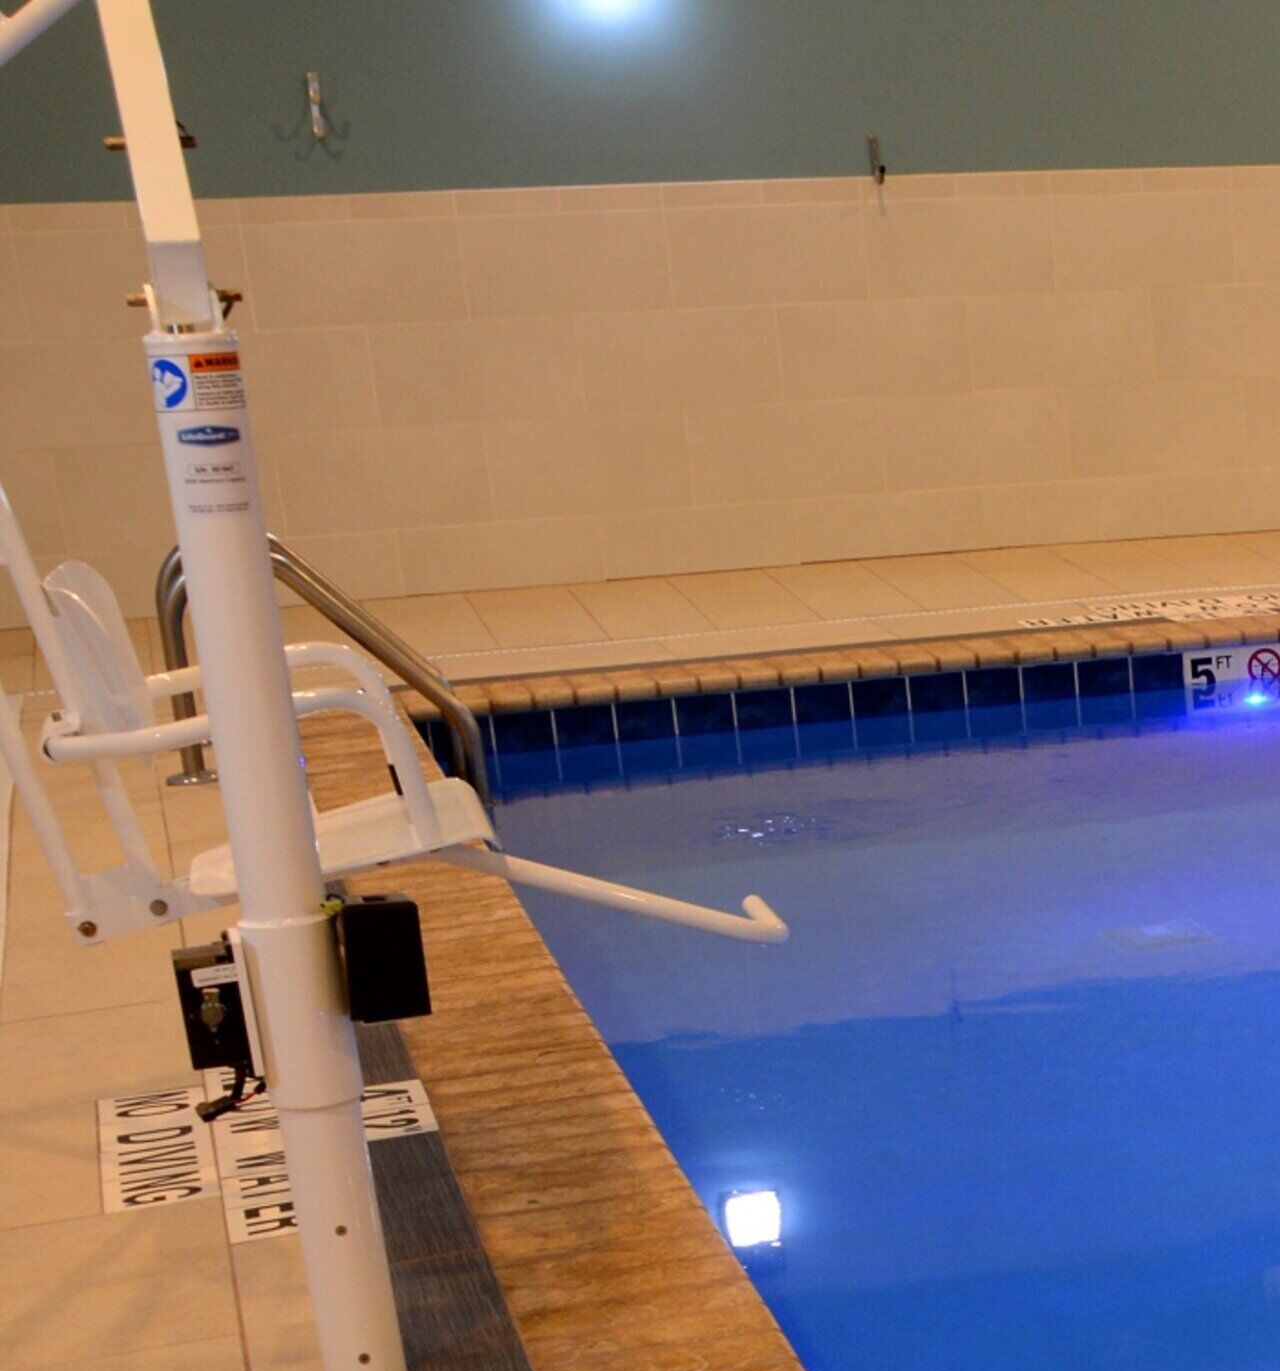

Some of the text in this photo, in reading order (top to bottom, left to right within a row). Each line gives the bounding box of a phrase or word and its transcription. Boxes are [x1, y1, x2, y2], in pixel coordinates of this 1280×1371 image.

[1190, 655, 1233, 685] 5 FT
[114, 1090, 203, 1207] NO DIVING
